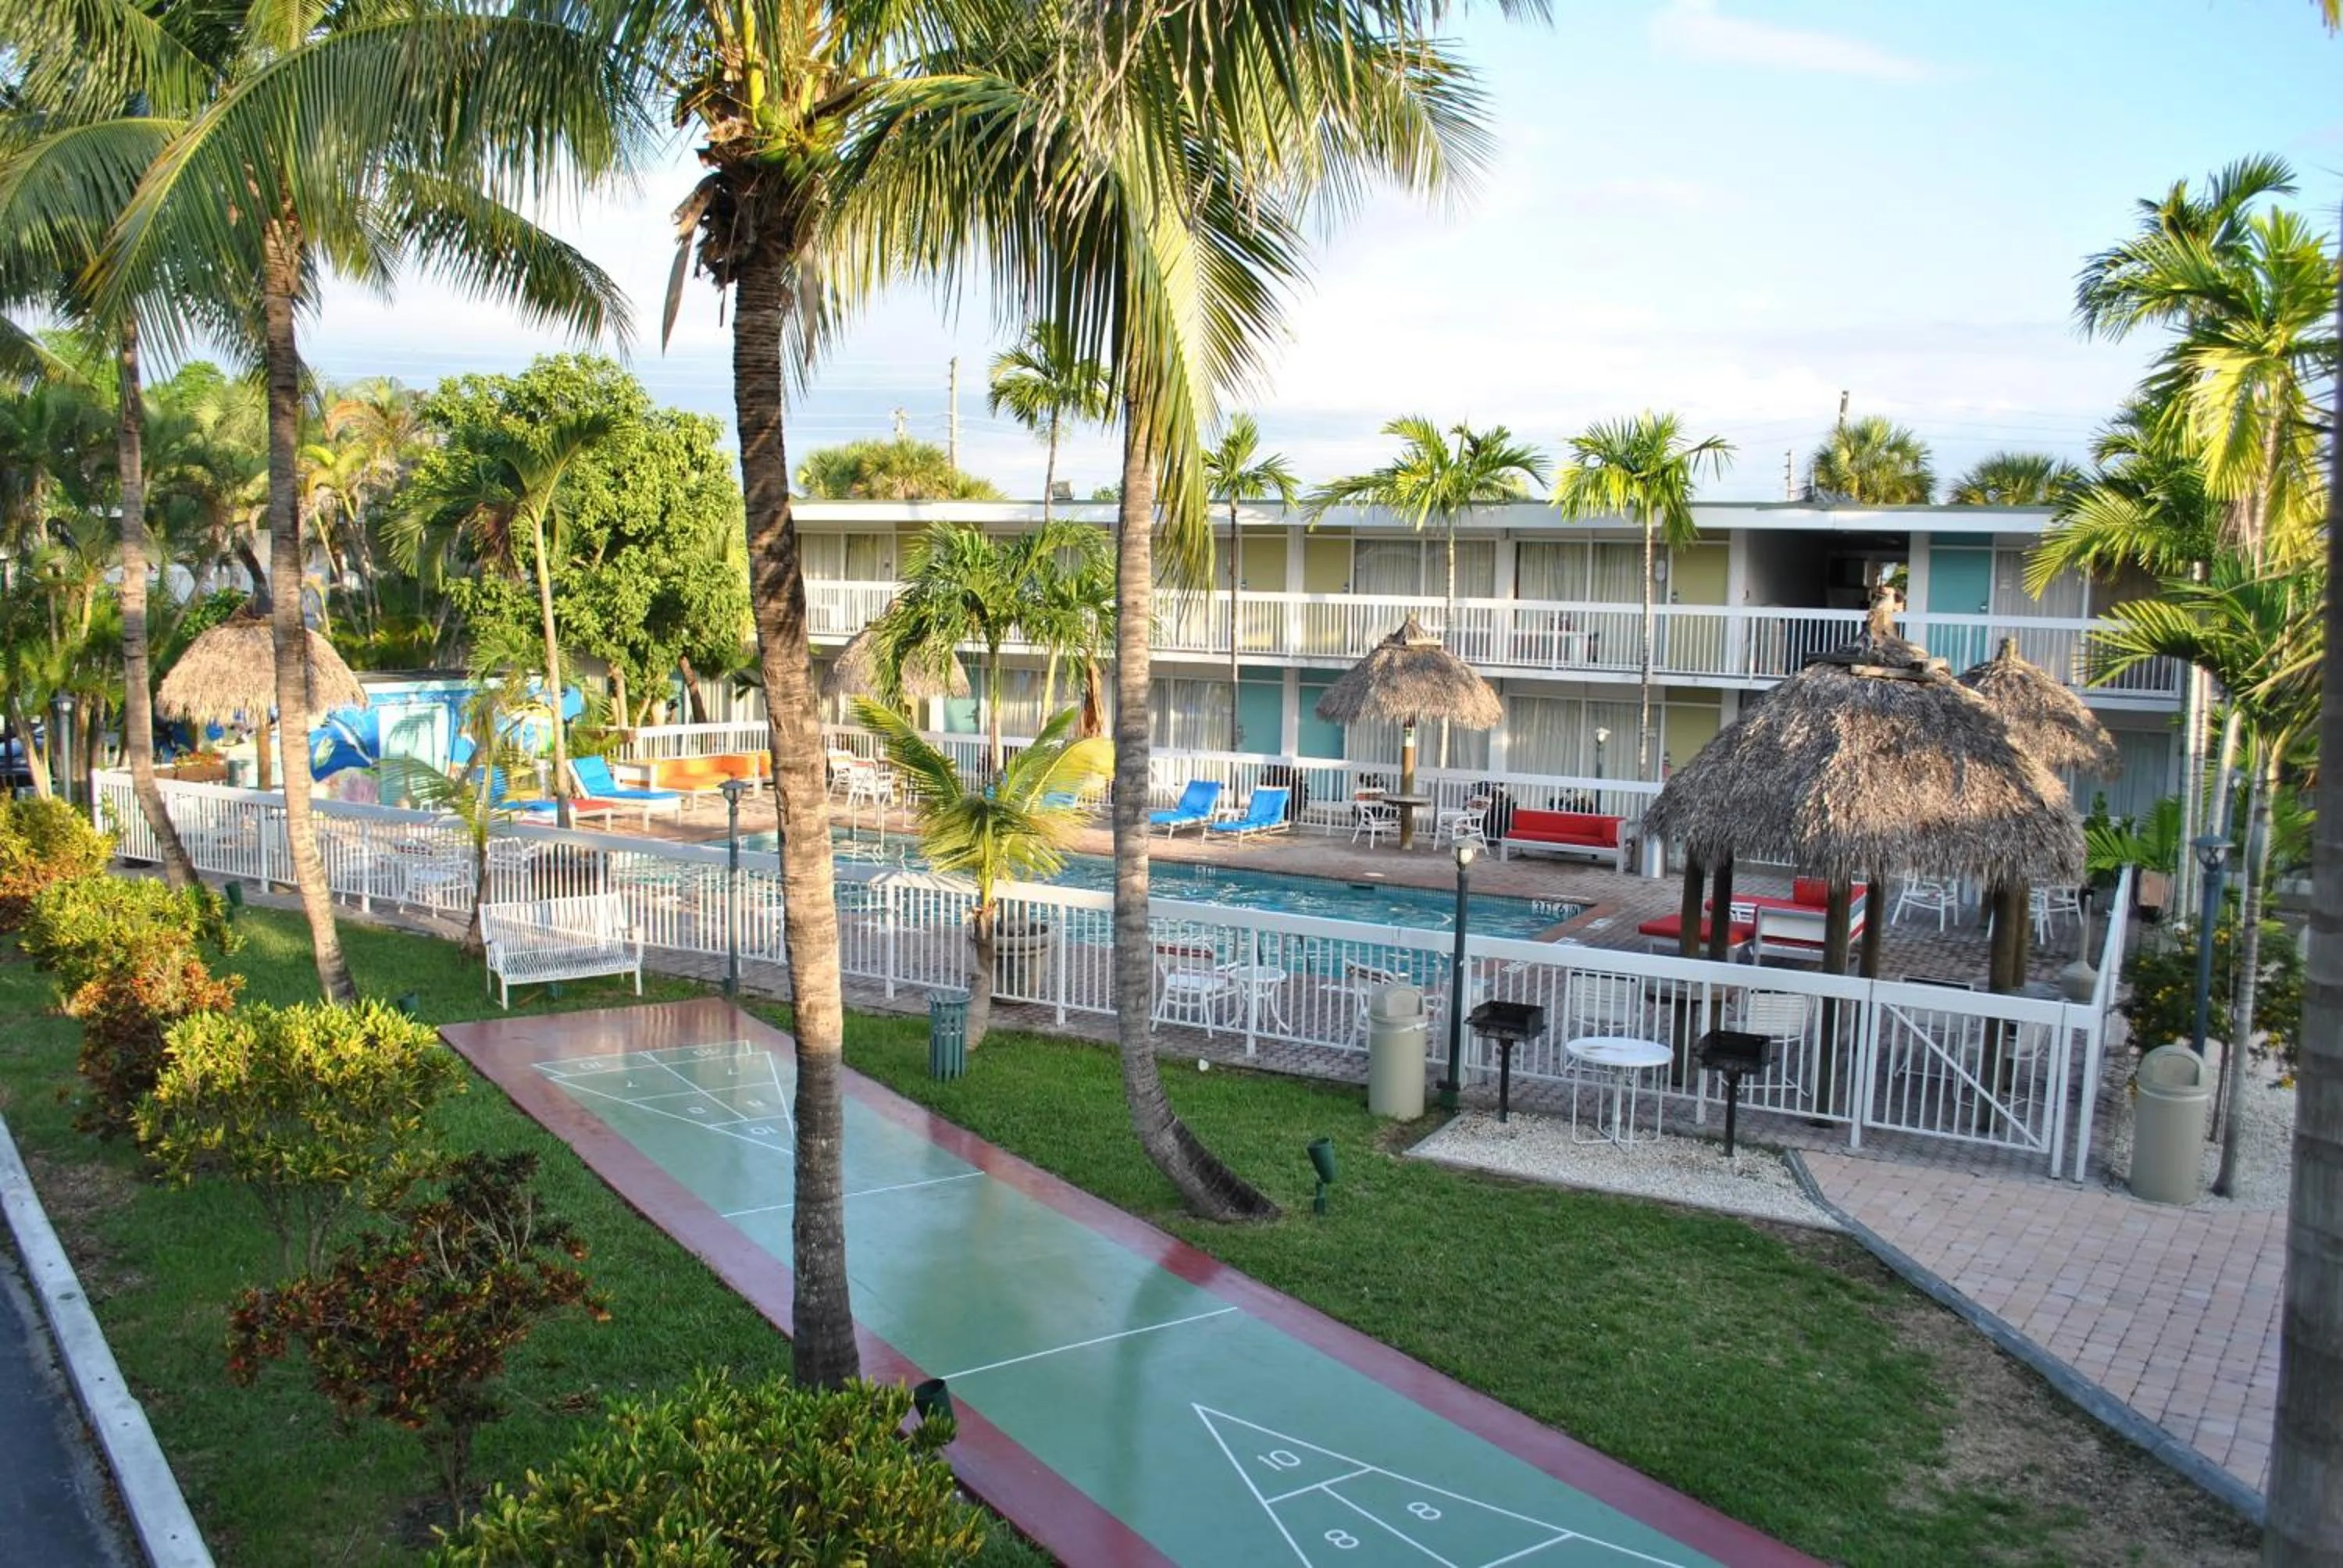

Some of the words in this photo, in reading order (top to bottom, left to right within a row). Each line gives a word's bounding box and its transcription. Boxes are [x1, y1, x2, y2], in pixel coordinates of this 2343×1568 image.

[1257, 1450, 1300, 1471] 10
[1407, 1502, 1442, 1520] 8
[1325, 1529, 1360, 1549] 8
